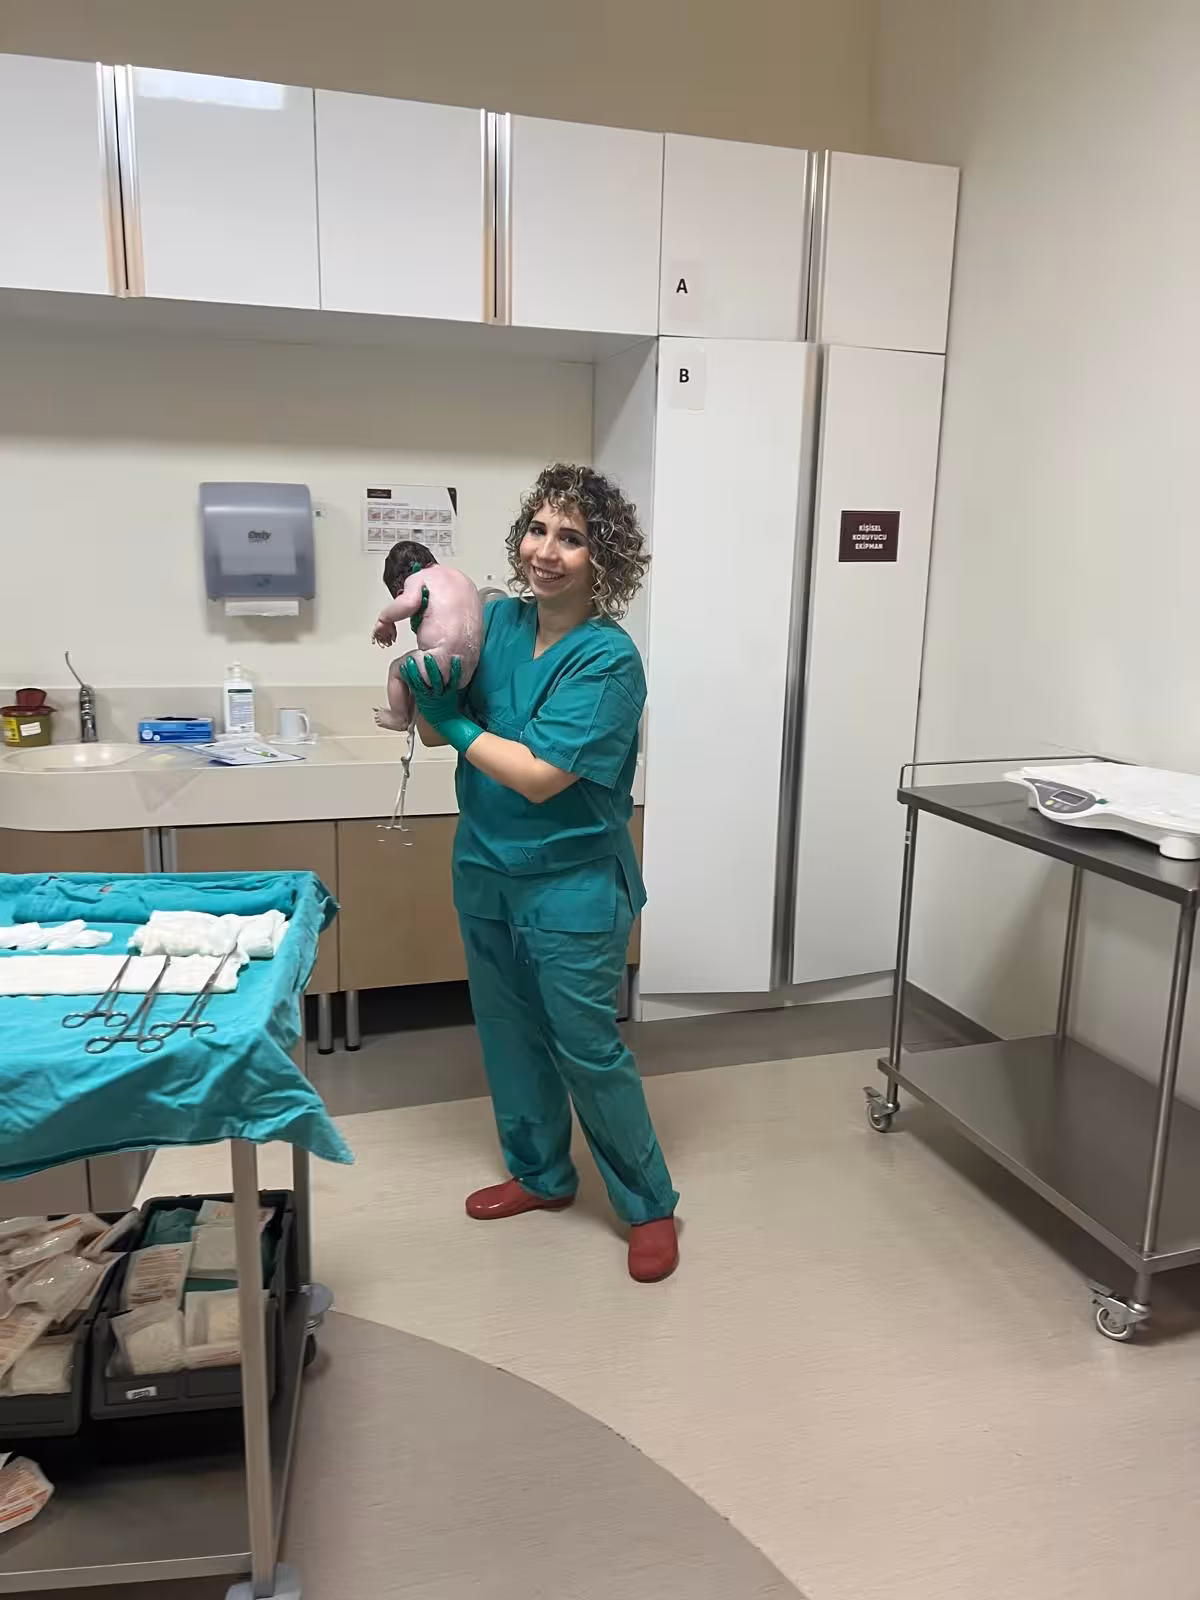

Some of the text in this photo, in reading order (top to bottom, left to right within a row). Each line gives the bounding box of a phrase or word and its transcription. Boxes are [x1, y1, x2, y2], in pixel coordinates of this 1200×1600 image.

[676, 278, 688, 294] A
[679, 368, 690, 383] B
[855, 542, 883, 550] EKİPMAN
